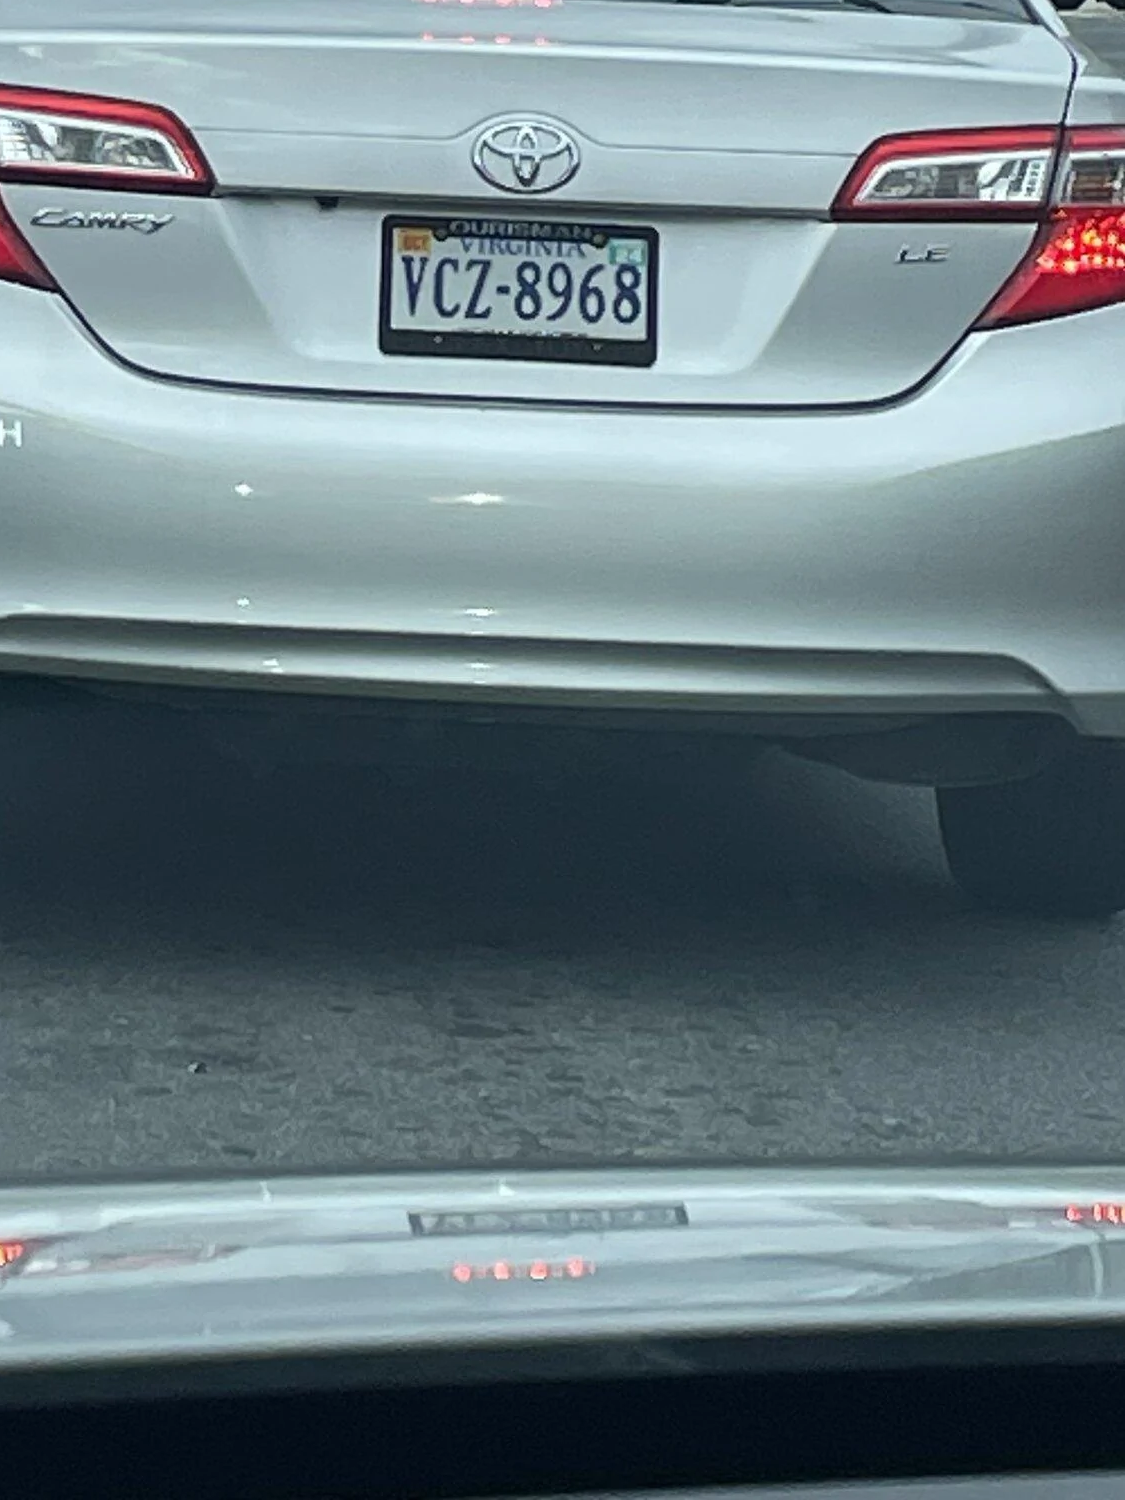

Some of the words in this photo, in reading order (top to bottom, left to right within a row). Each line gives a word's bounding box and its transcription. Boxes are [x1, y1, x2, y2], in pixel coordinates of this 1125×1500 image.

[30, 207, 175, 235] CAMRY
[458, 236, 590, 259] VIRGINIA
[893, 243, 951, 265] LE
[401, 255, 643, 325] VCZ-8968
